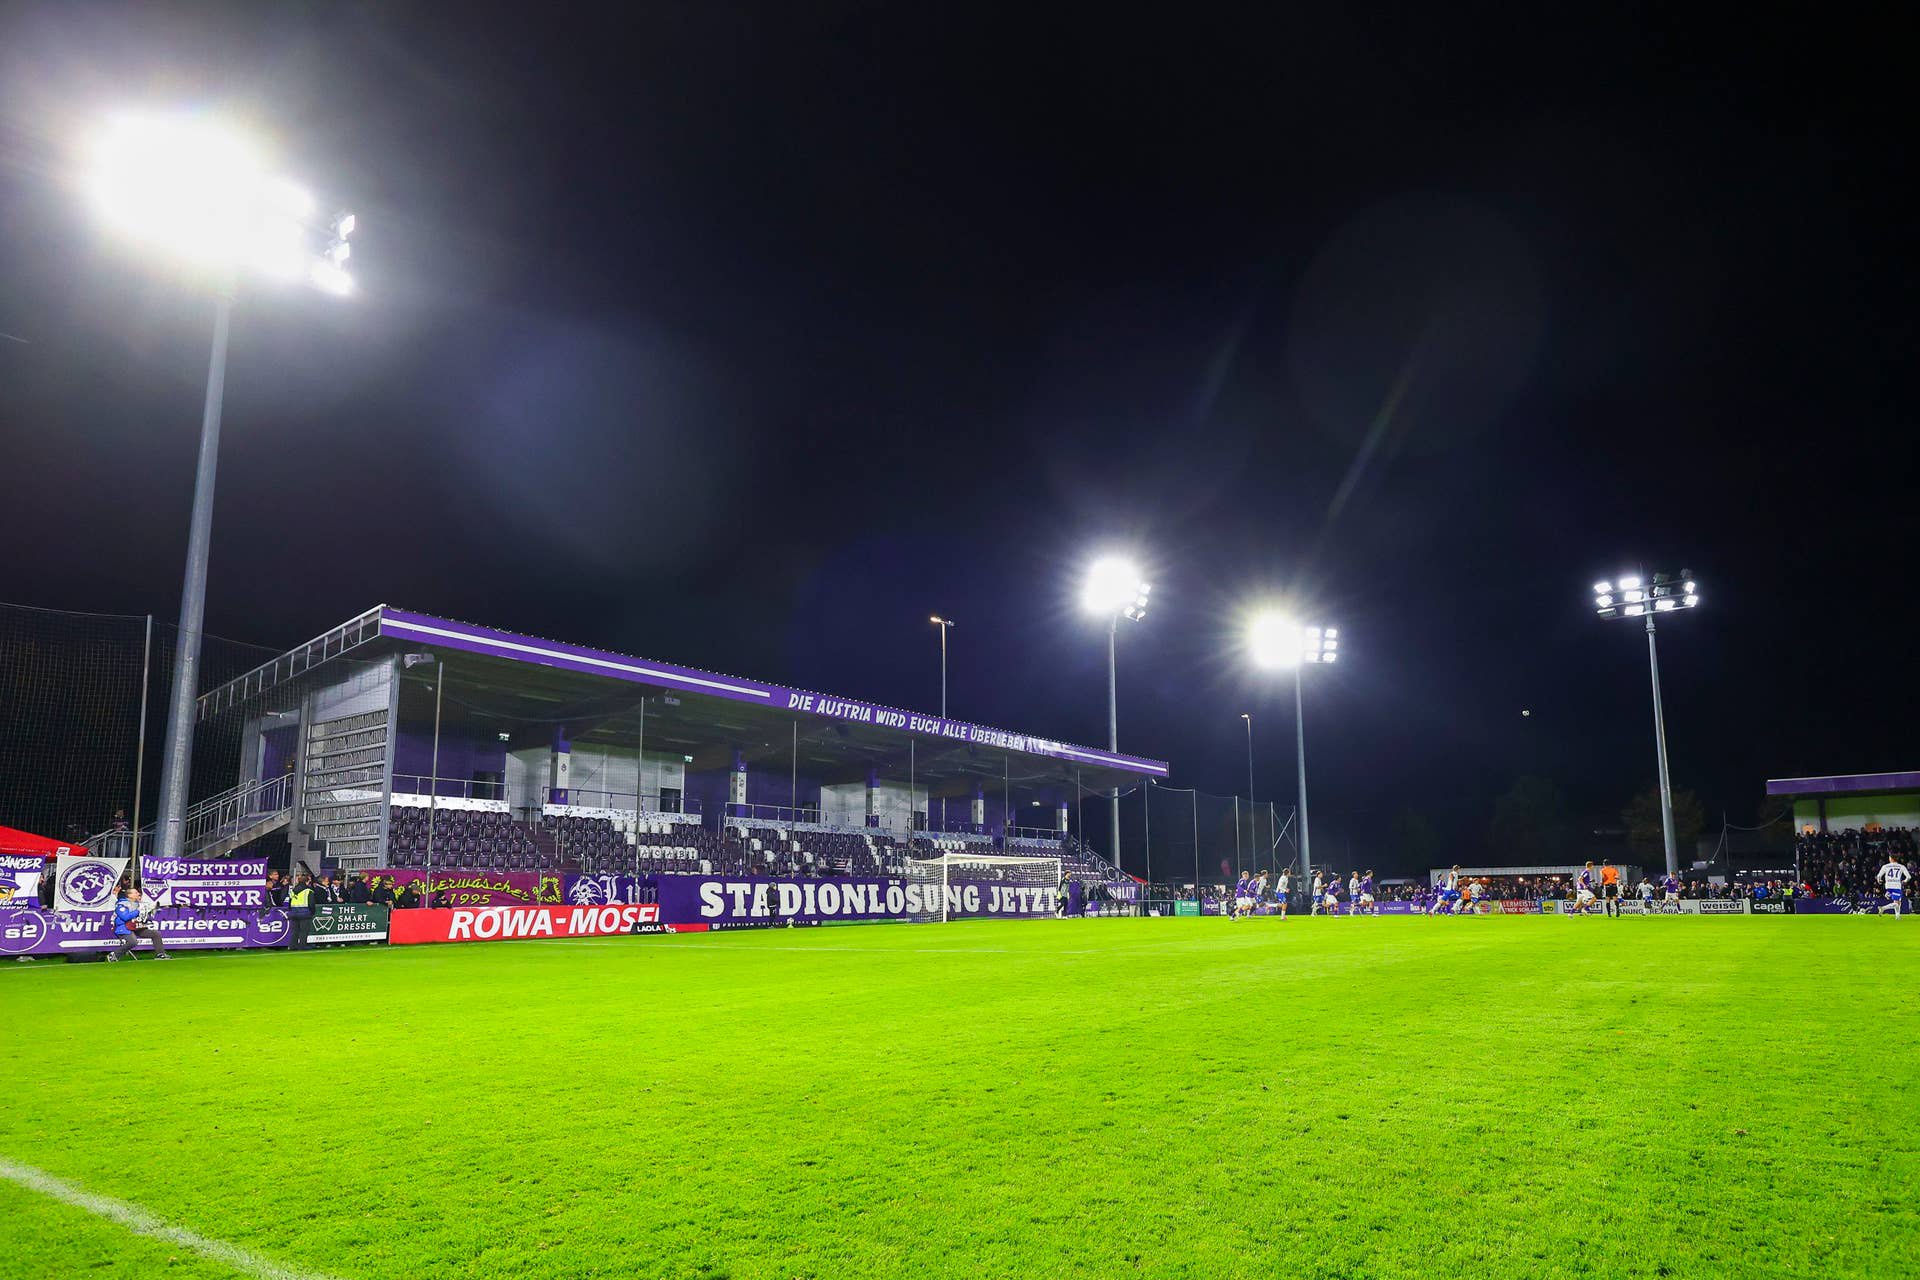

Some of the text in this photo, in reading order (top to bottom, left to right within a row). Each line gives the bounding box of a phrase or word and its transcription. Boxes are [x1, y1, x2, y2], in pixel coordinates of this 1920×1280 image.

[788, 693, 1026, 751] DIE AUSTRIA WIRD EUCH ALLE ÜBERLEBEN
[144, 858, 179, 875] 4493
[177, 863, 265, 876] SEKTION
[1887, 868, 1901, 879] 47
[174, 890, 263, 906] STEYR
[449, 893, 492, 904] 1995
[699, 880, 980, 917] STADIONLÖSUNG
[987, 885, 1057, 913] JETZT
[338, 906, 356, 914] THE
[1702, 900, 1742, 909] weiser
[1753, 901, 1785, 912] capel
[337, 914, 368, 923] SMART
[337, 922, 377, 931] DRESSER
